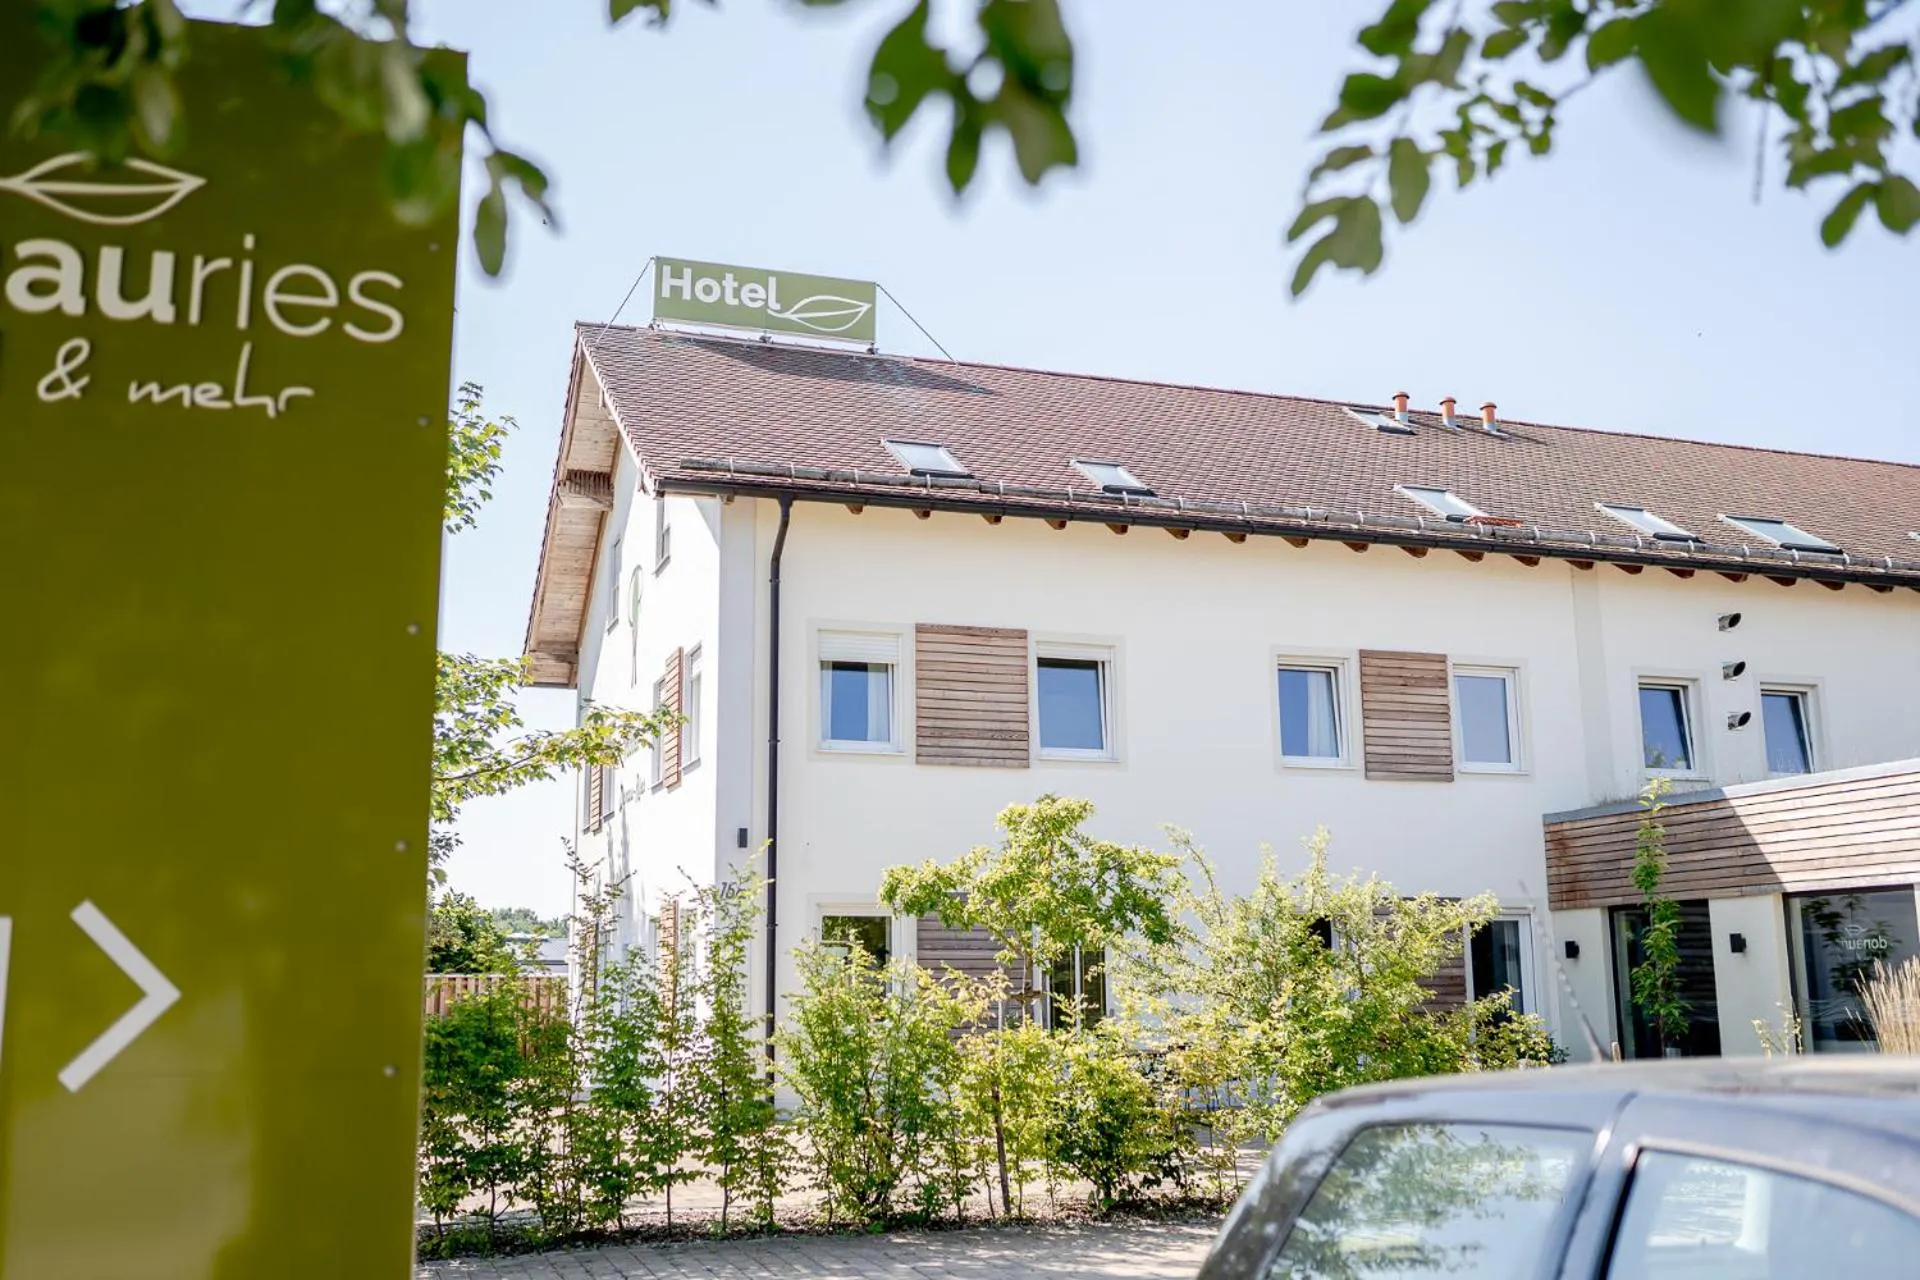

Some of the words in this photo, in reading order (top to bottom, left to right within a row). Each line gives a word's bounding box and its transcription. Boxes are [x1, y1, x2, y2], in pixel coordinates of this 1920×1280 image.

[660, 264, 782, 311] Hotel
[36, 337, 91, 402] &
[128, 341, 315, 418] mehr
